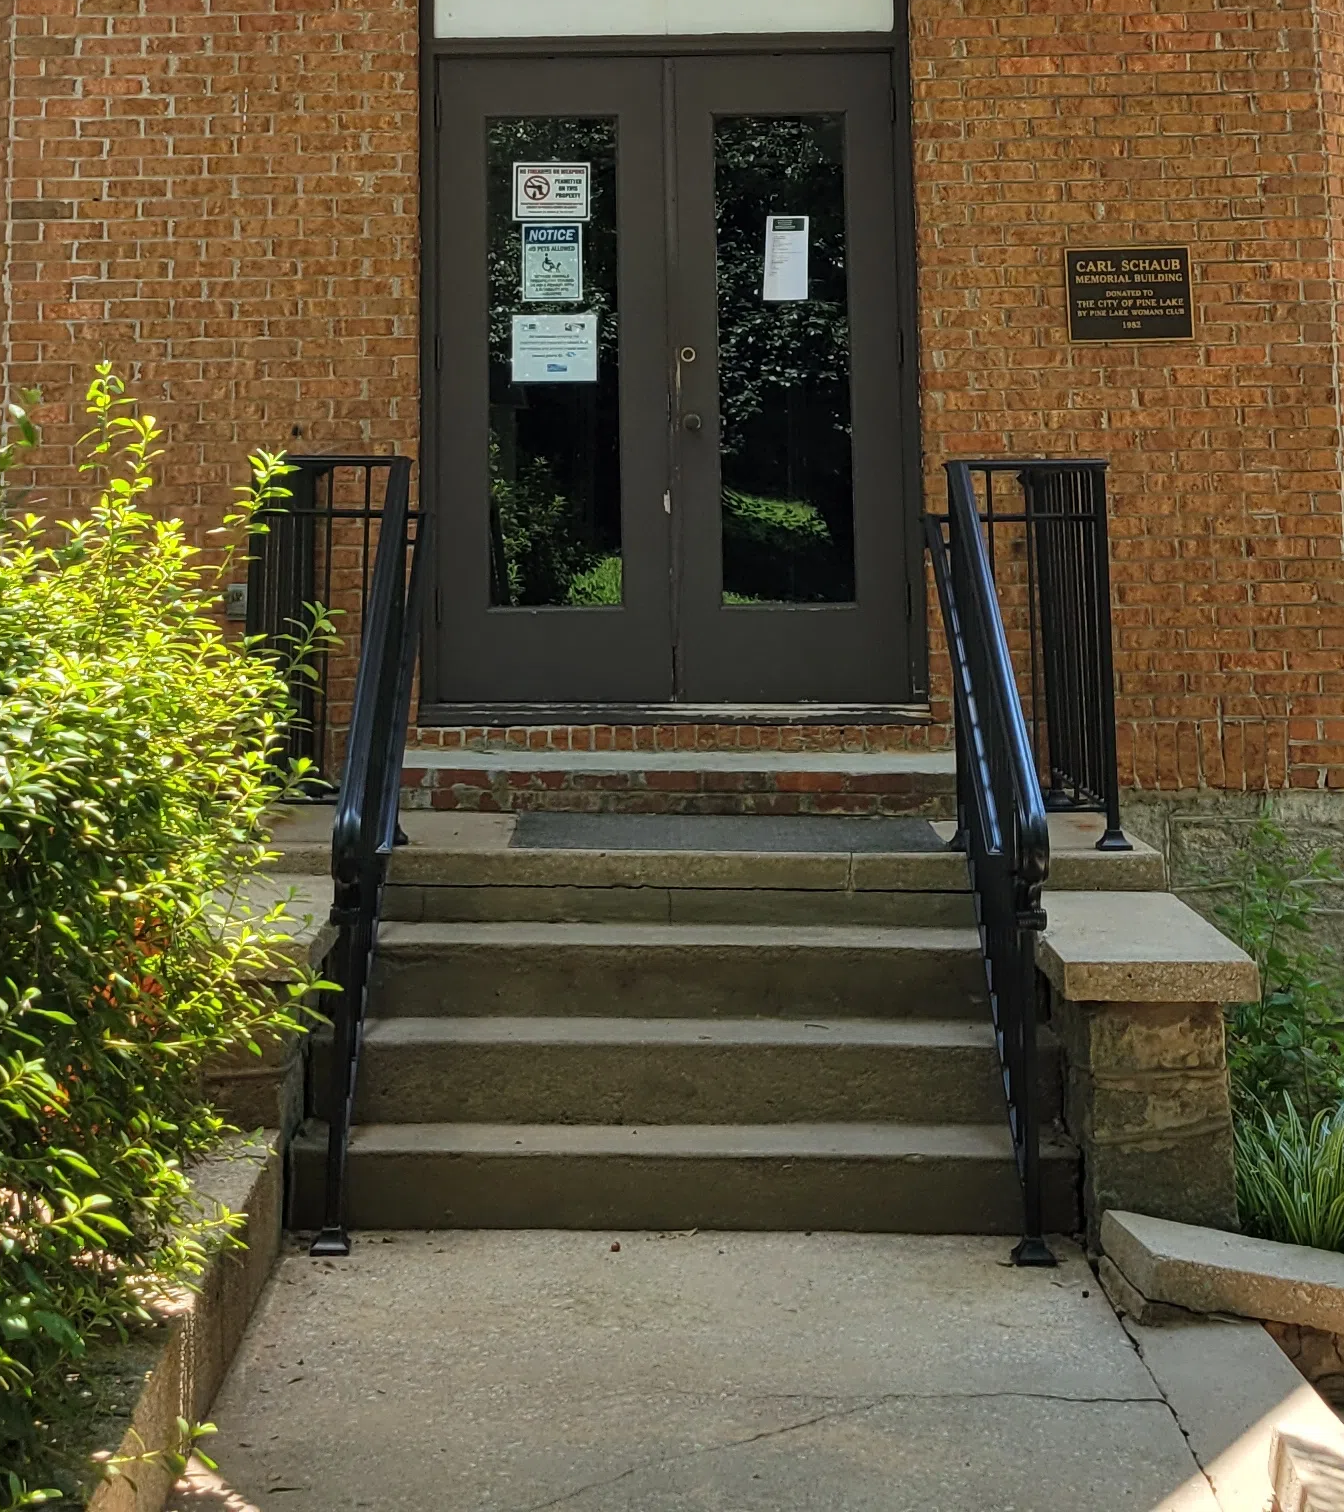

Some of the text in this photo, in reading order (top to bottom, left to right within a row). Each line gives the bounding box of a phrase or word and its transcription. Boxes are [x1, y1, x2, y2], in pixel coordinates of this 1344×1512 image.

[529, 230, 576, 241] NOTICE
[1076, 259, 1180, 272] CARL SCHAUB
[1075, 273, 1183, 284] MEMORIAL BUILDING
[1077, 300, 1094, 308] THE
[1160, 298, 1184, 306] LAKE
